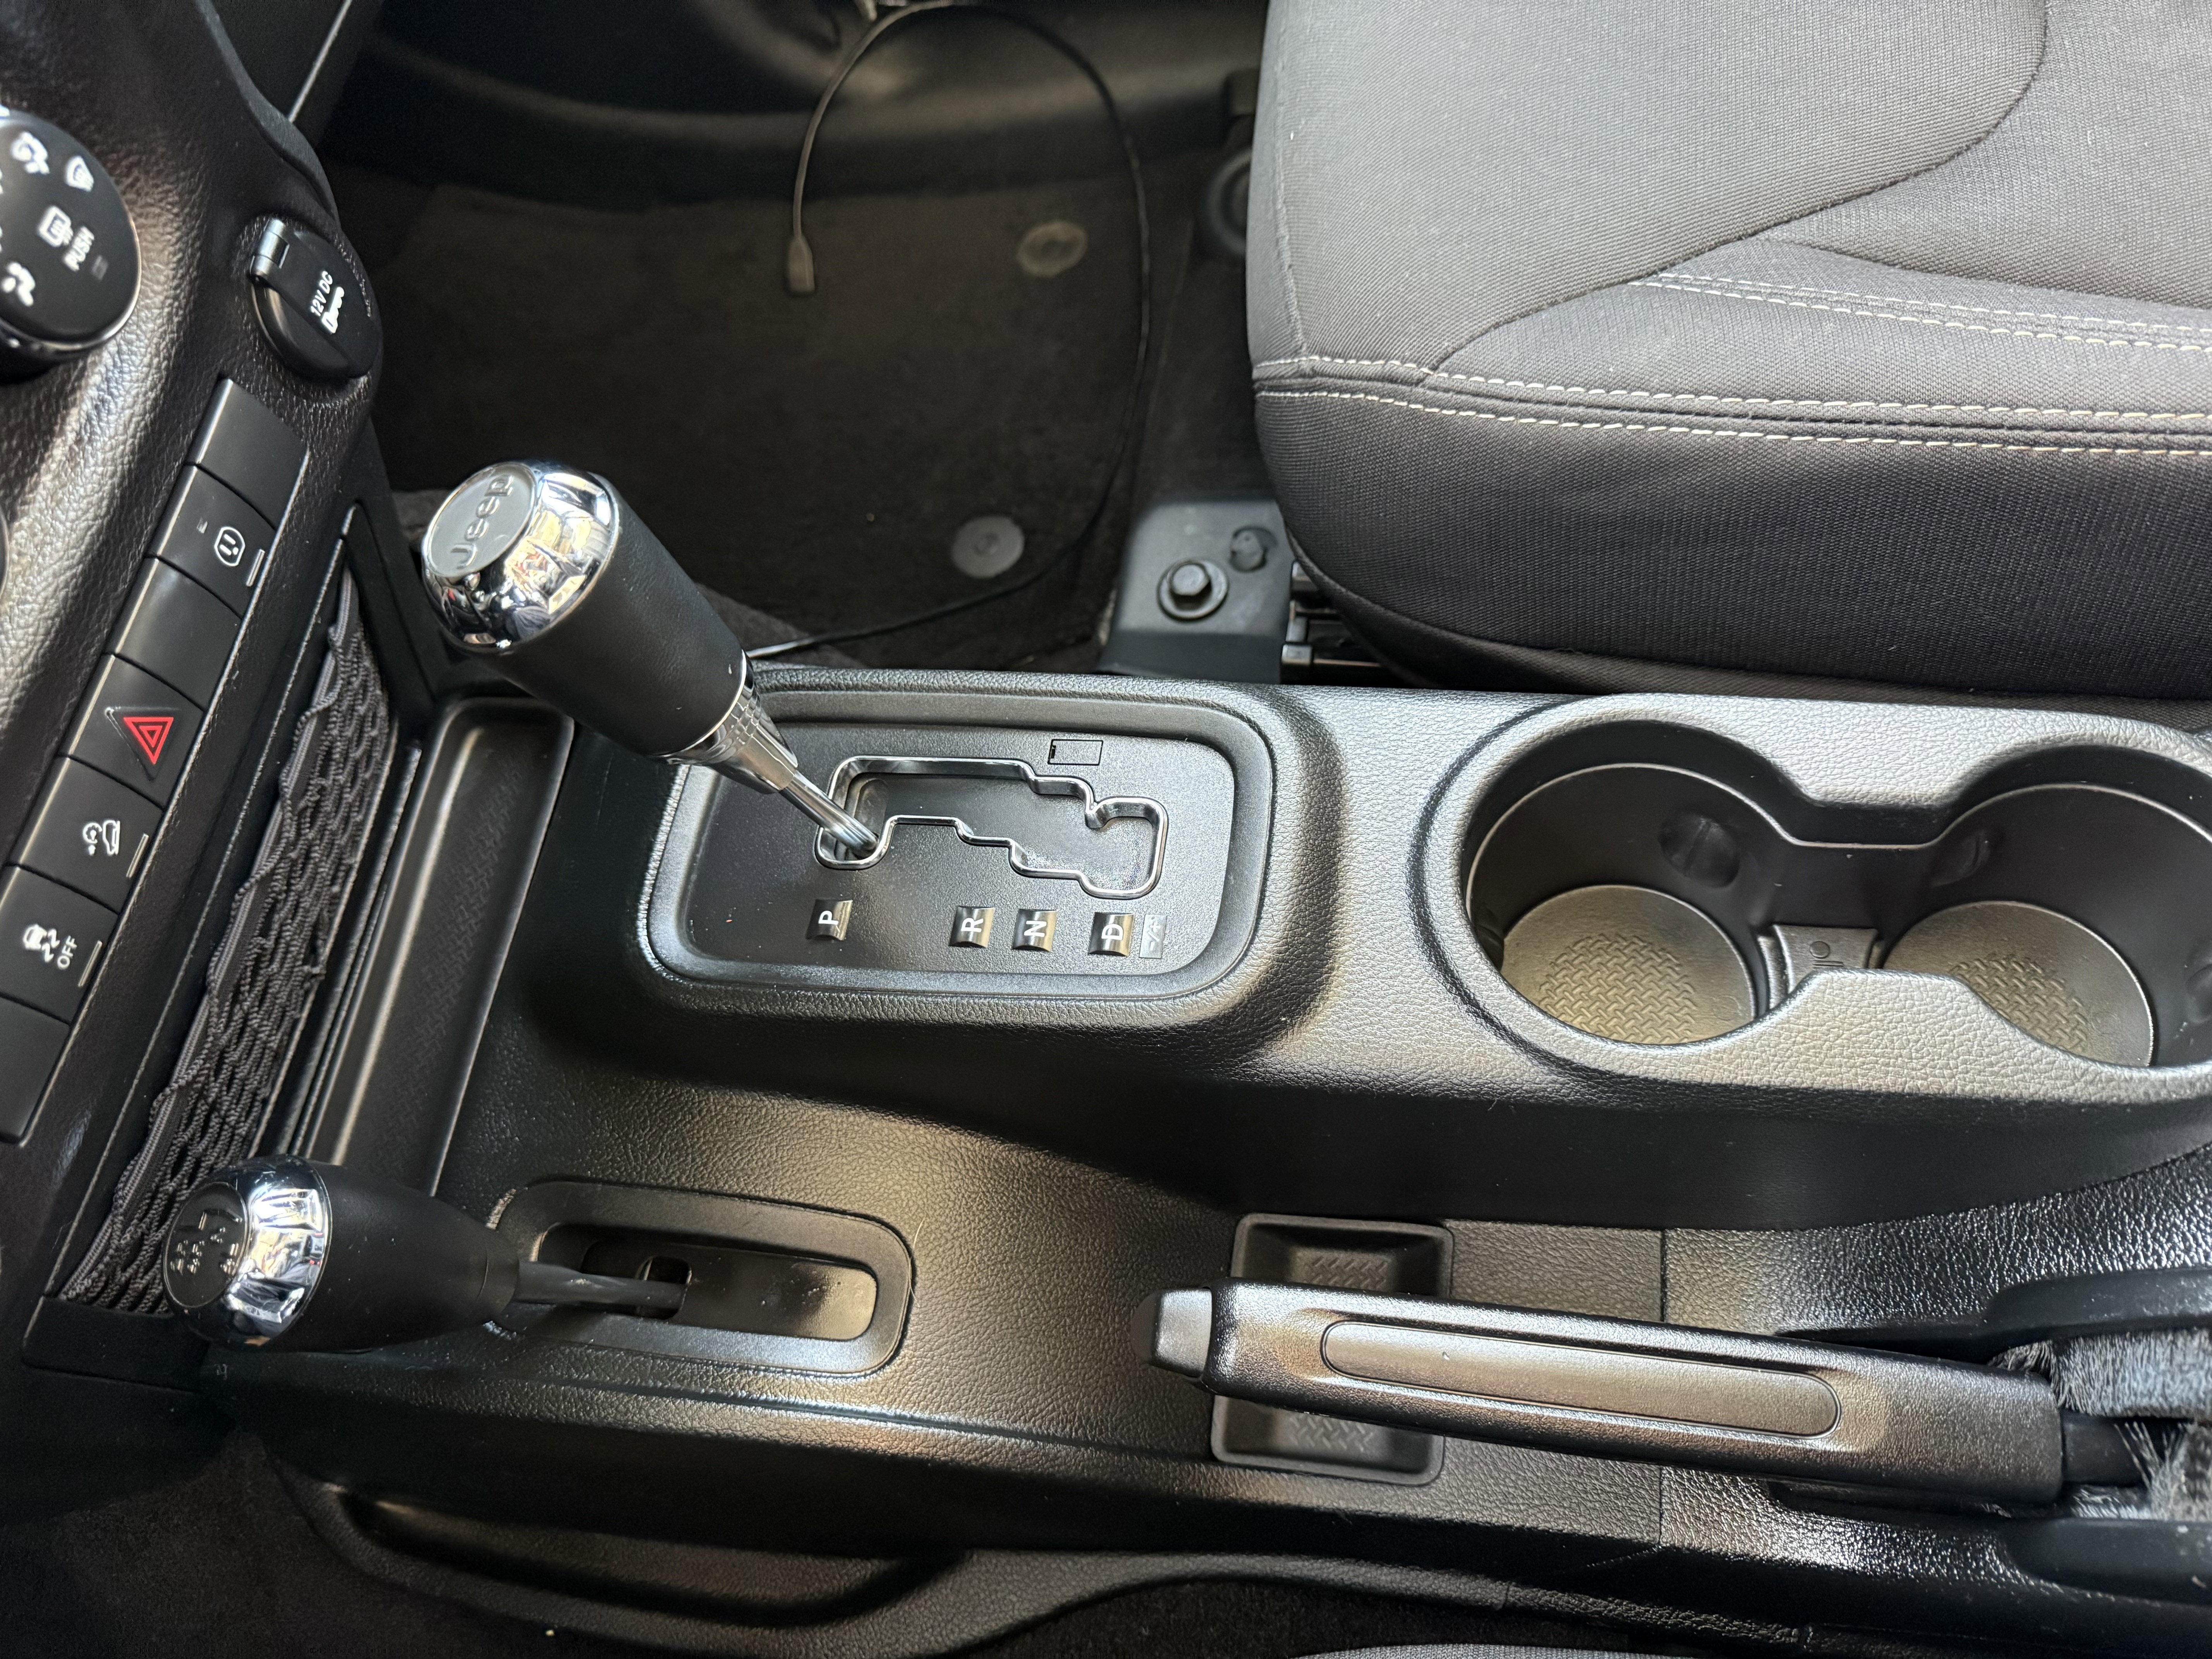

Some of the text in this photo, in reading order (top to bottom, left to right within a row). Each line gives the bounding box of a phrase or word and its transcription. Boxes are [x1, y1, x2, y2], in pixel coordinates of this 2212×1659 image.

[64, 226, 94, 271] PUSH
[311, 271, 333, 316] 12V DC
[450, 475, 514, 569] Jeep
[818, 910, 838, 925] P
[961, 917, 983, 933] R
[1024, 920, 1046, 937] N
[1101, 924, 1123, 940] D
[57, 935, 77, 970] OFF
